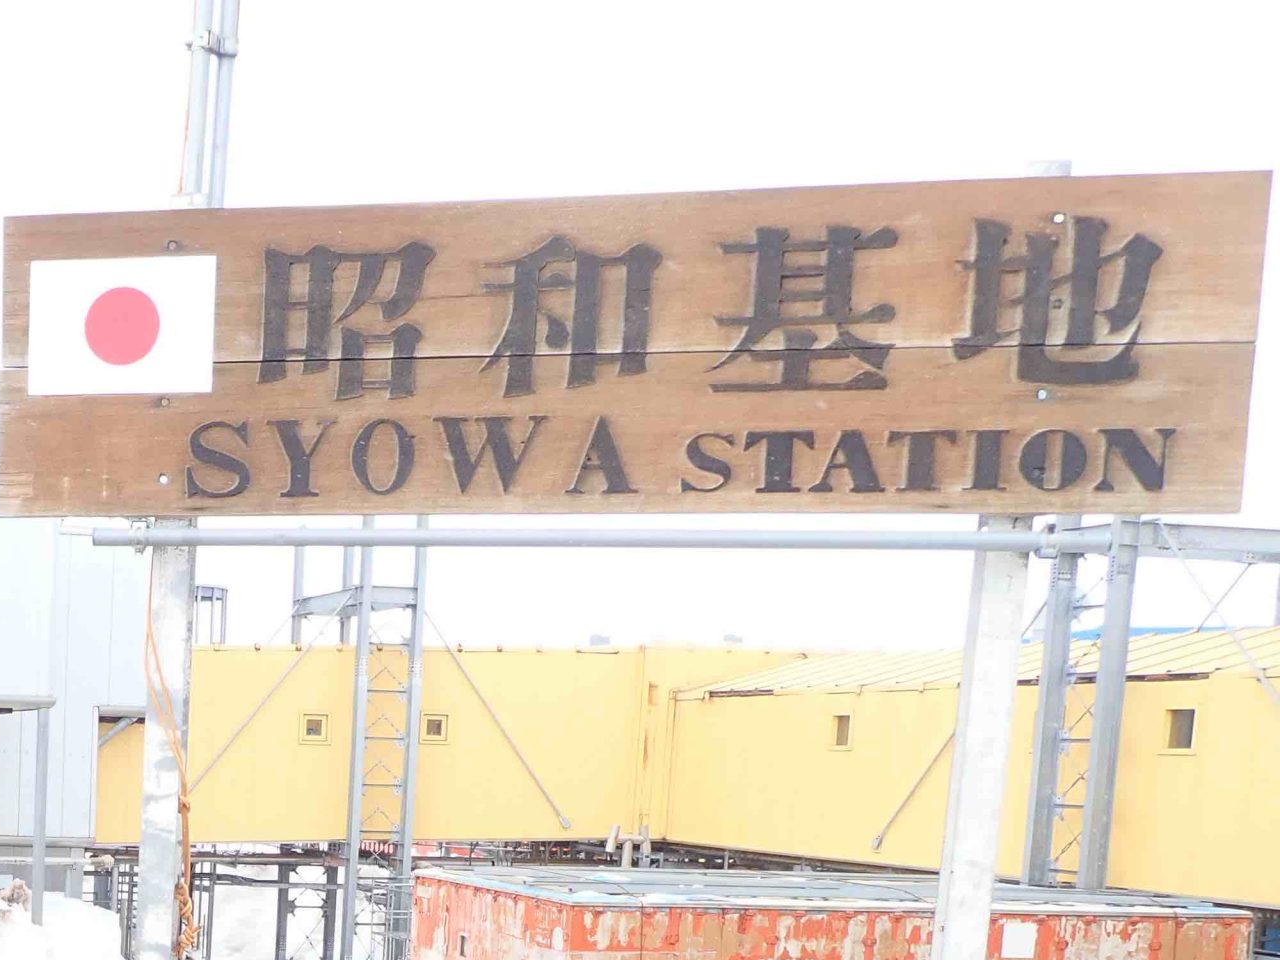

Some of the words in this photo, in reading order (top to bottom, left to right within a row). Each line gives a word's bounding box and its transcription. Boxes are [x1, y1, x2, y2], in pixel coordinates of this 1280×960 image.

[257, 215, 1164, 400] 昭和基地
[184, 414, 639, 499] SYOWA
[681, 426, 1178, 494] STATION
